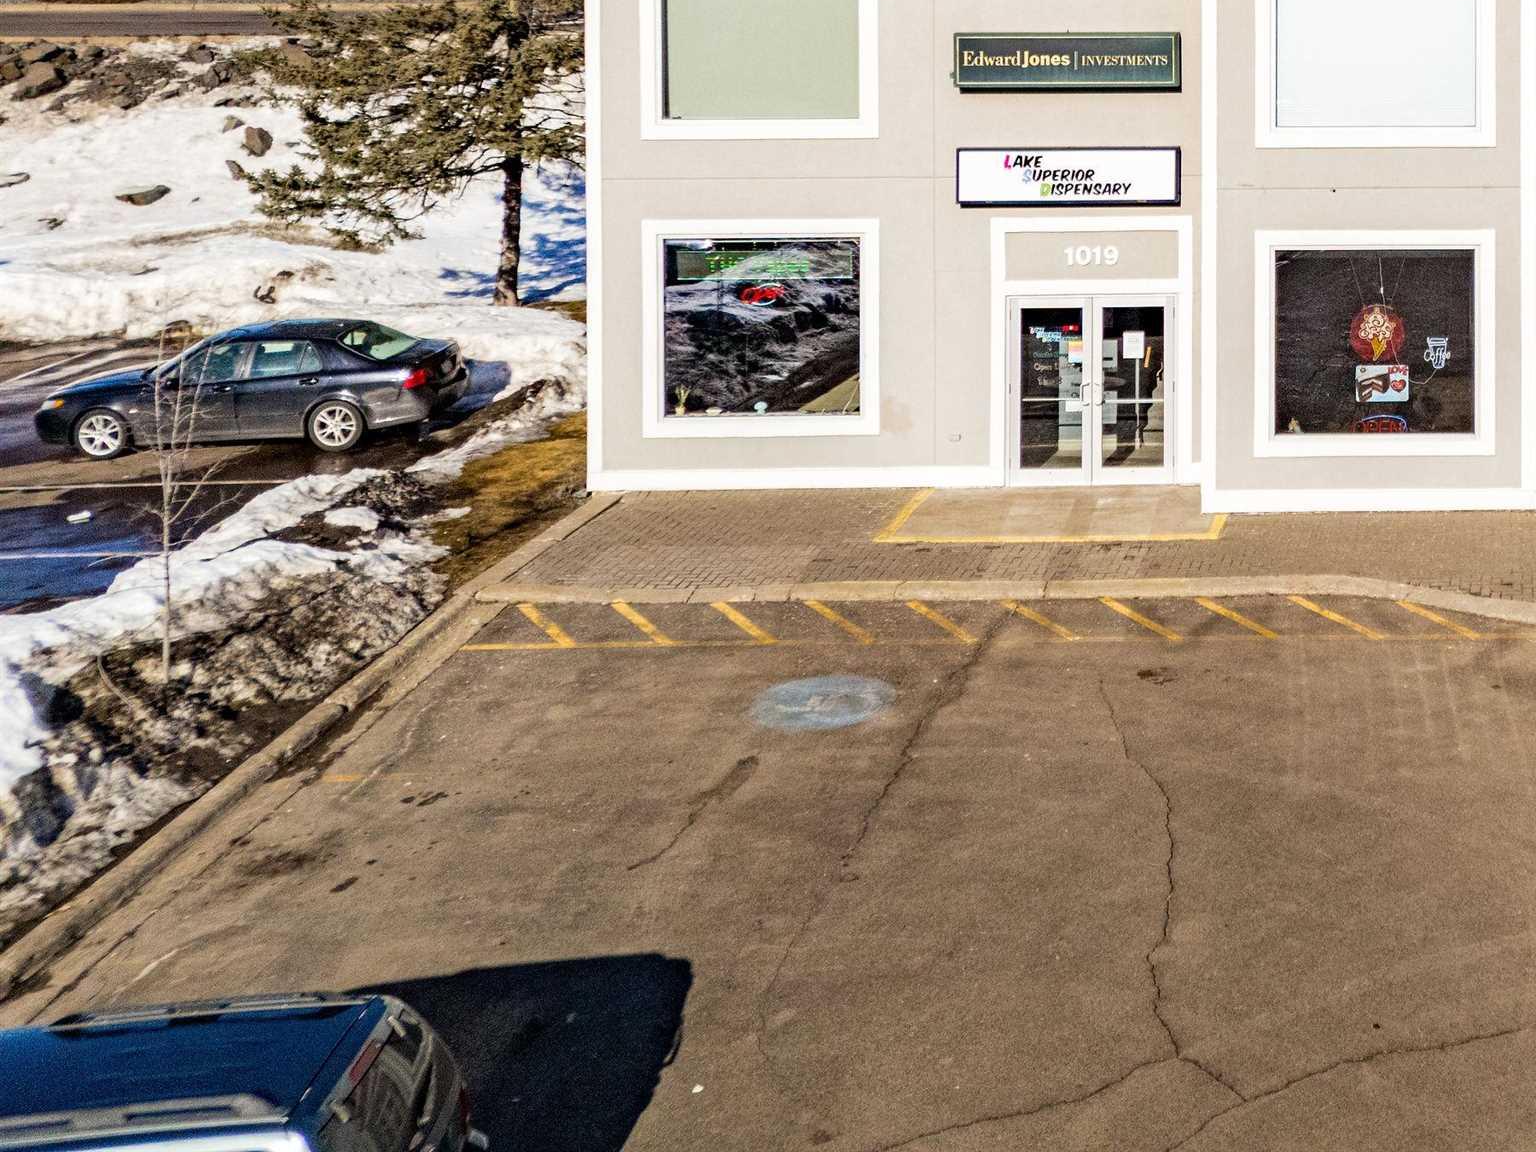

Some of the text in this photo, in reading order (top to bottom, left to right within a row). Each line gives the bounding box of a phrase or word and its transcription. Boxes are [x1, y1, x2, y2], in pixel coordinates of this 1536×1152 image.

[1081, 55, 1168, 66] INVESTMENTS
[1003, 154, 1043, 170] LAKE
[1022, 168, 1095, 184] SUPERIOR
[1039, 182, 1132, 197] DISPENSARY
[1063, 246, 1120, 266] 1019
